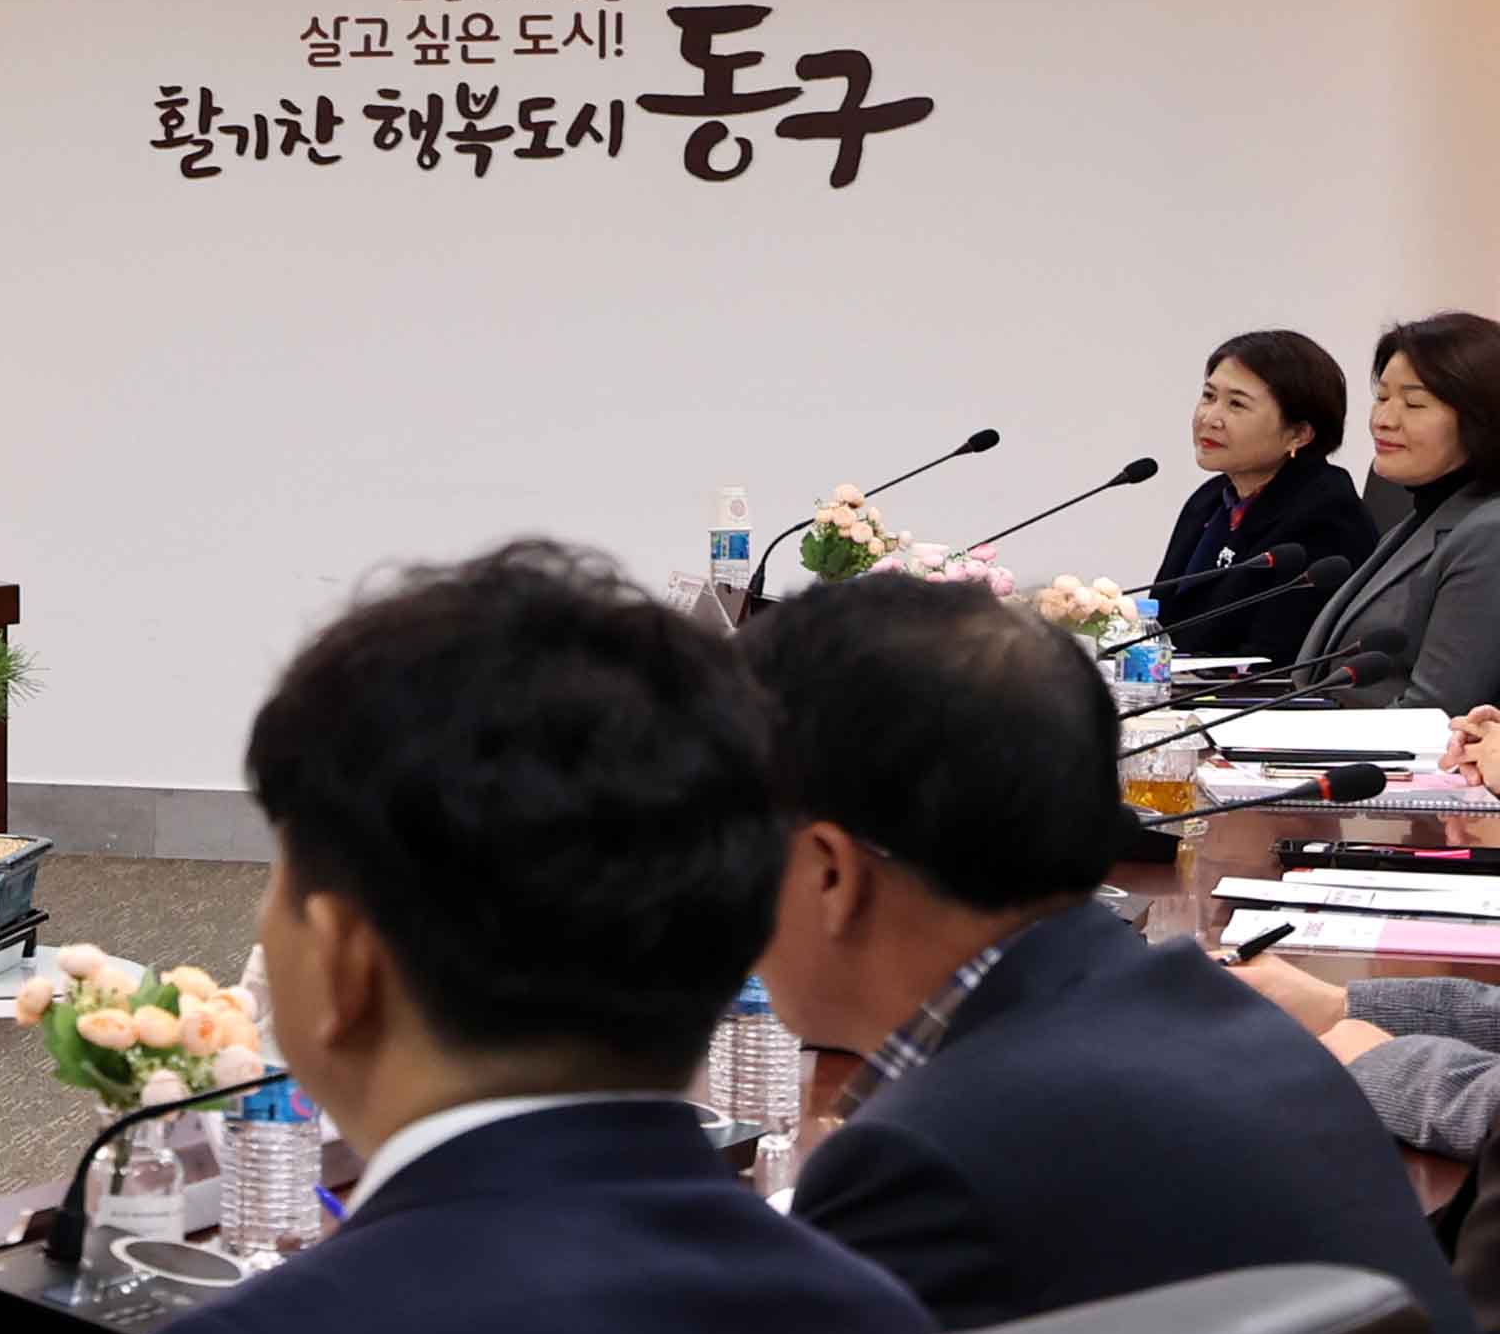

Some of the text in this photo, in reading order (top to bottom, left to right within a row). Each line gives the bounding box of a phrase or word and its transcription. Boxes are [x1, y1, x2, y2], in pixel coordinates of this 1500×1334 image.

[150, 3, 936, 189] 활기찬 행복도시 동구
[299, 9, 625, 68] 살고 싶은 도시!
